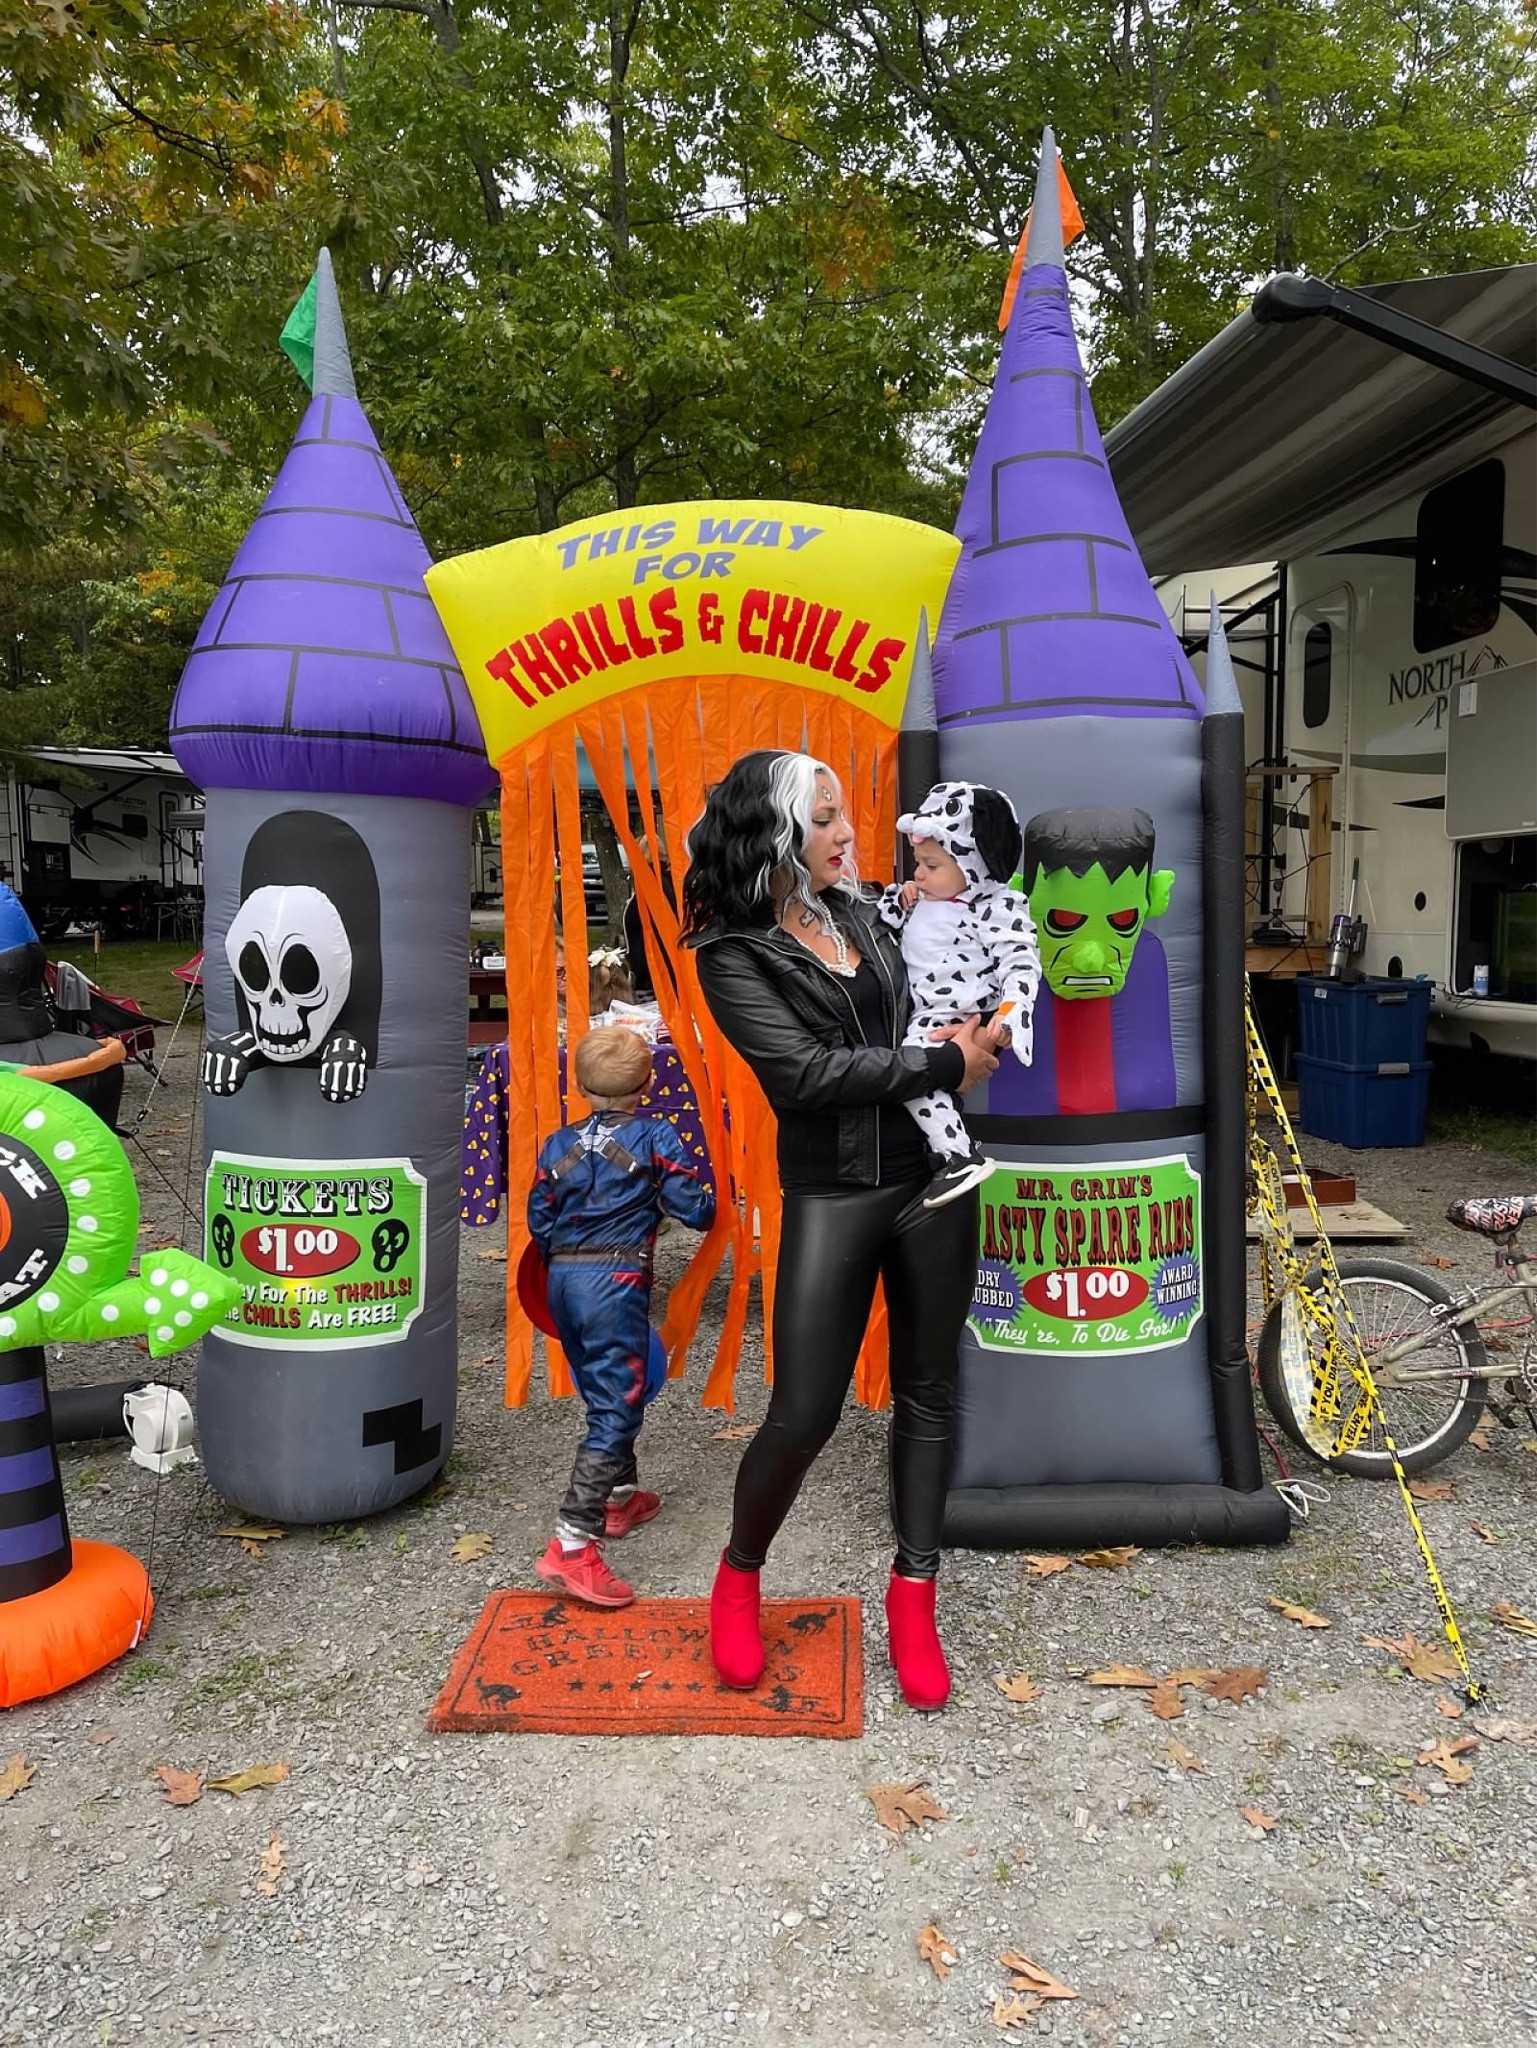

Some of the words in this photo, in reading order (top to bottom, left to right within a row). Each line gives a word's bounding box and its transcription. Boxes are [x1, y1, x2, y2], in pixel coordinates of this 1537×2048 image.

[557, 519, 677, 570] THIS
[696, 517, 825, 553] WAY
[632, 550, 737, 586] FOR
[485, 586, 686, 708] THRILLS
[697, 592, 725, 644] &
[737, 588, 907, 694] CHILLS
[1388, 651, 1466, 704] NORTH
[222, 1172, 393, 1217] TICKETS
[1016, 1178, 1063, 1200] MR.
[1070, 1174, 1153, 1200] GRIM'S
[983, 1203, 1047, 1266] ASTY
[1054, 1203, 1142, 1267] SPARE
[1148, 1194, 1194, 1262] RIBS
[258, 1227, 338, 1272] $1.00
[260, 1282, 288, 1304] For
[295, 1285, 328, 1304] The
[333, 1276, 413, 1304] THRILLS!
[977, 1269, 1000, 1288] DRY
[1160, 1263, 1194, 1287] AWARD
[972, 1287, 1014, 1308] UBBED
[1046, 1270, 1130, 1318] $1.00
[1156, 1279, 1198, 1306] WINNING
[243, 1302, 301, 1329] CHILLS
[307, 1308, 344, 1329] Are
[347, 1302, 397, 1327] FREE!
[1071, 1323, 1089, 1344] To
[1322, 1384, 1335, 1404] YOU
[528, 1626, 797, 1656] HALLOWN
[511, 1644, 805, 1682] GREETIS
